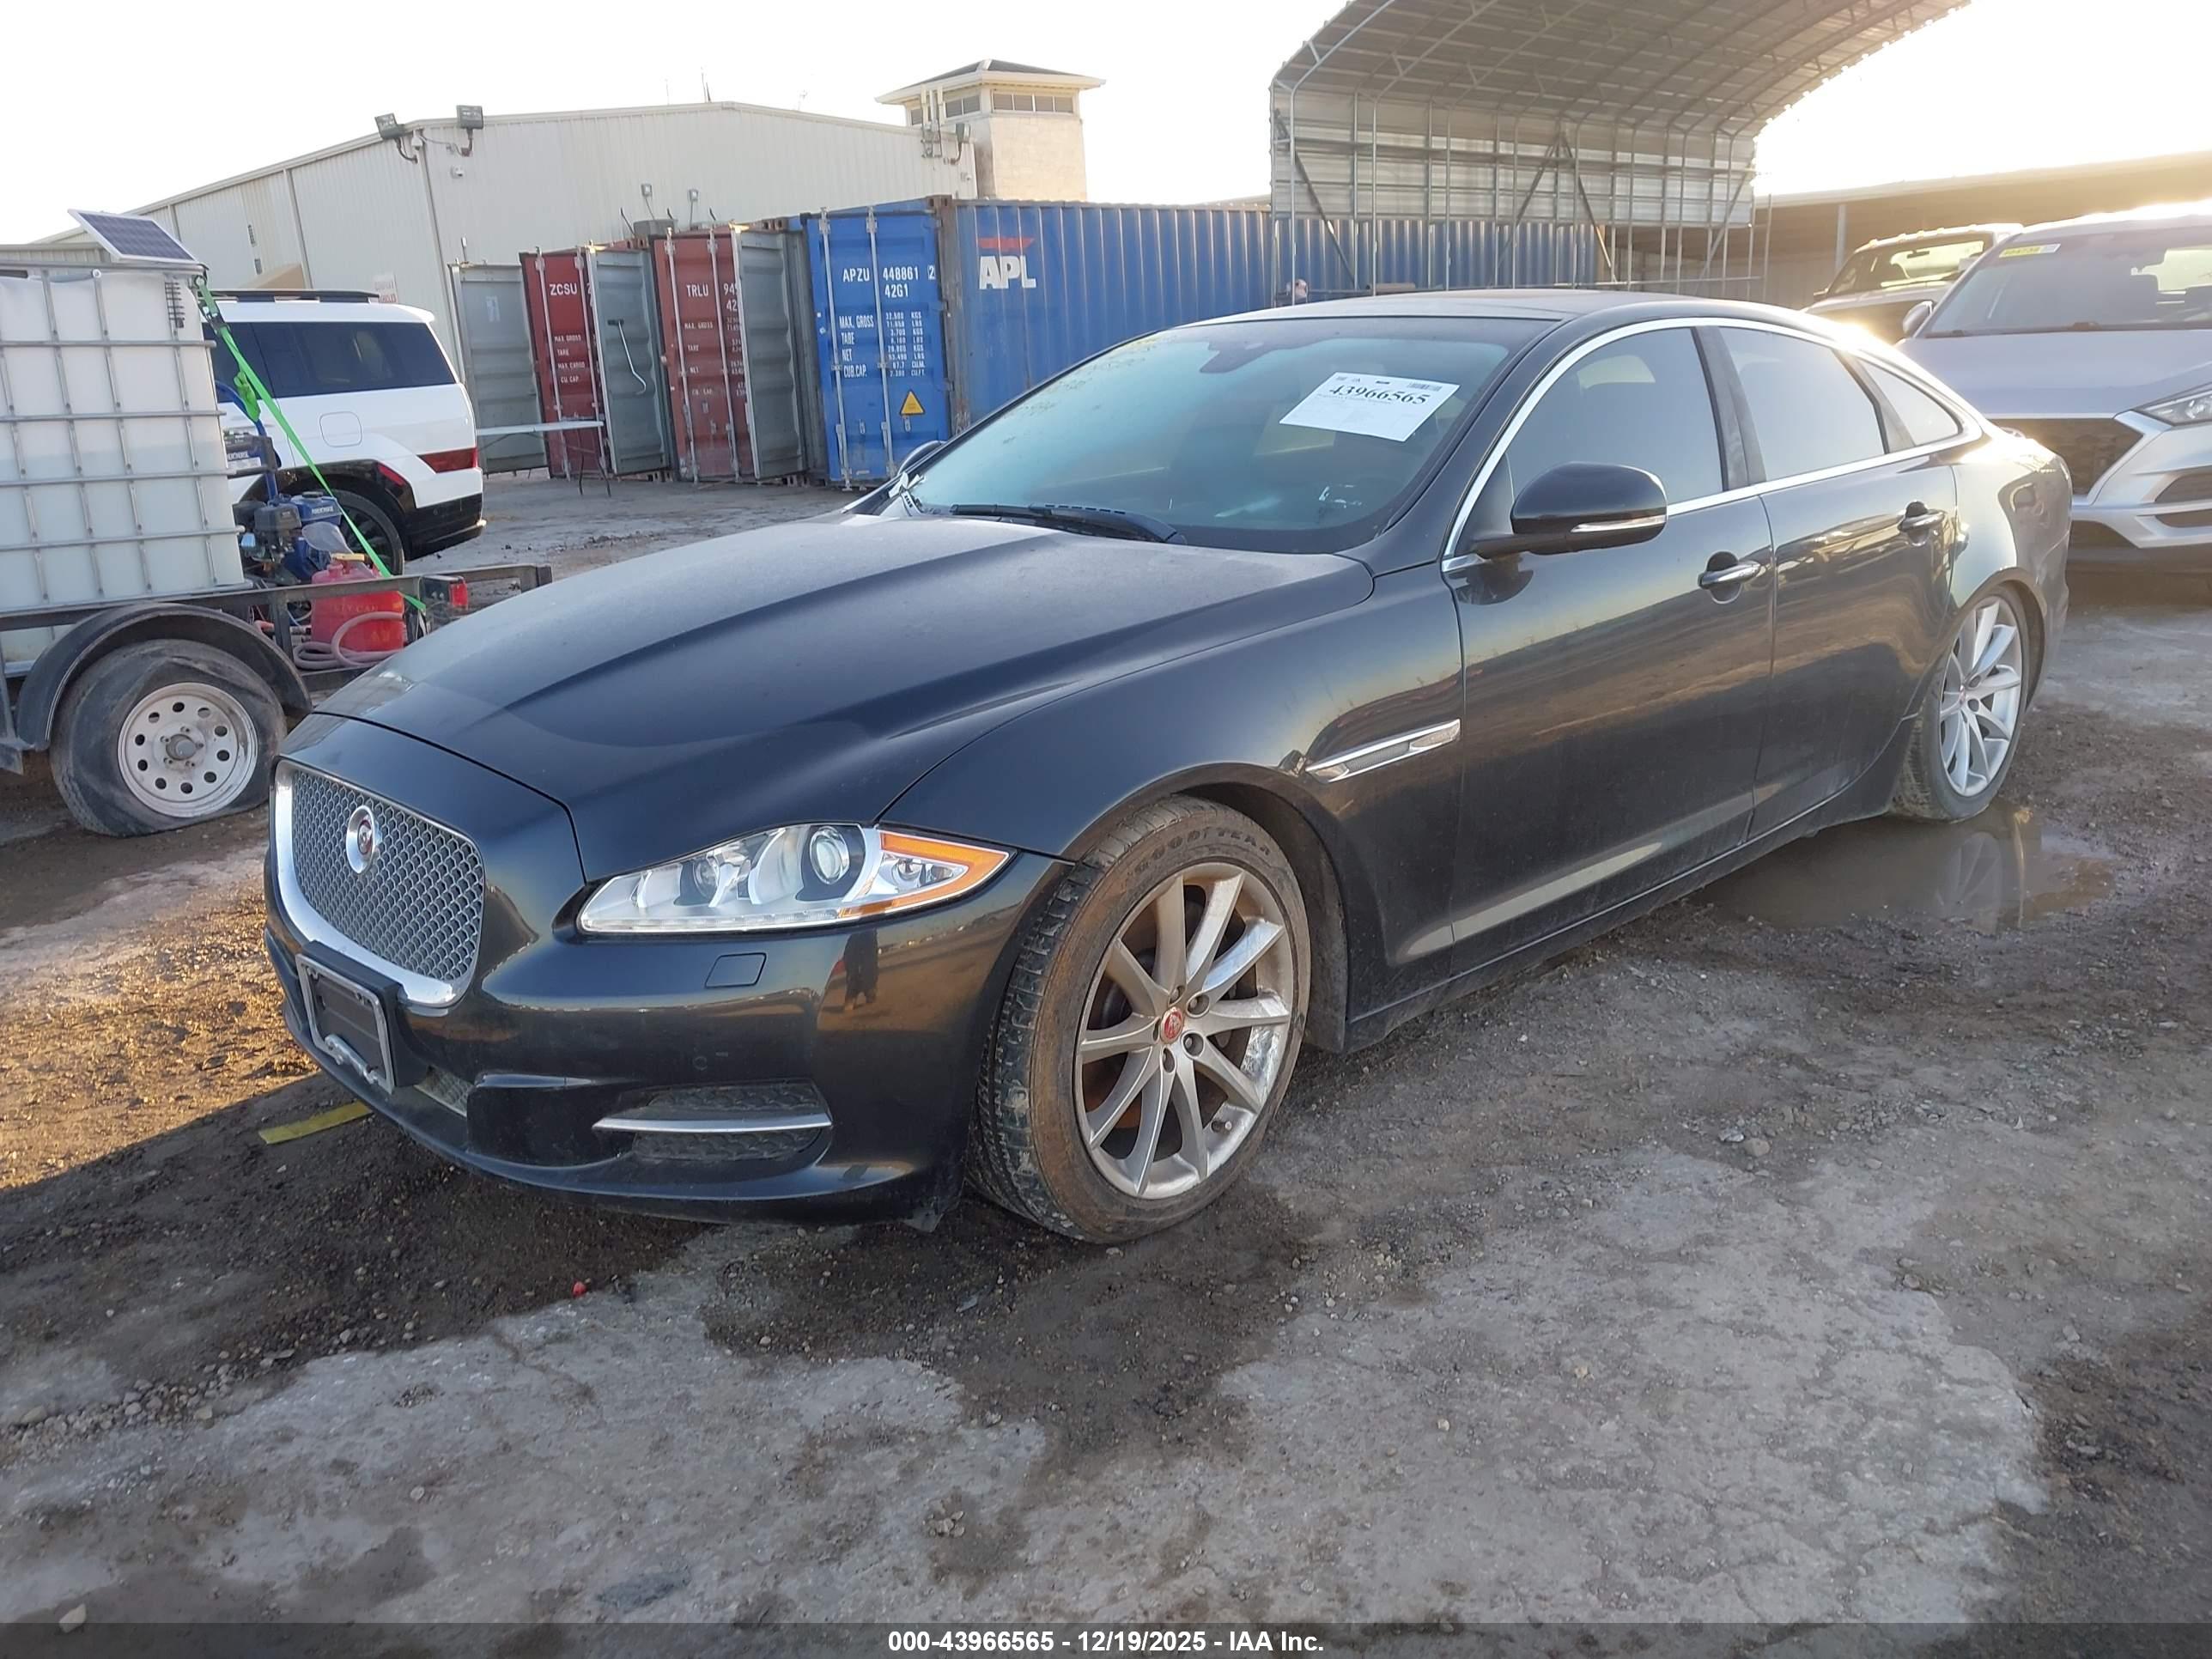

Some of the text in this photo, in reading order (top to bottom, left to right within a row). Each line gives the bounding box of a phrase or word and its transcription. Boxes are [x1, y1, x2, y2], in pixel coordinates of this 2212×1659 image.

[842, 264, 936, 283] APZU 448861 2
[980, 255, 1036, 289] APL
[550, 283, 578, 296] ZCSU
[686, 283, 709, 297] TRLU
[884, 283, 908, 298] 42G1
[856, 314, 874, 328] GROSS
[841, 332, 855, 344] TARE
[842, 349, 852, 362] NET
[1328, 385, 1431, 405] 43966565
